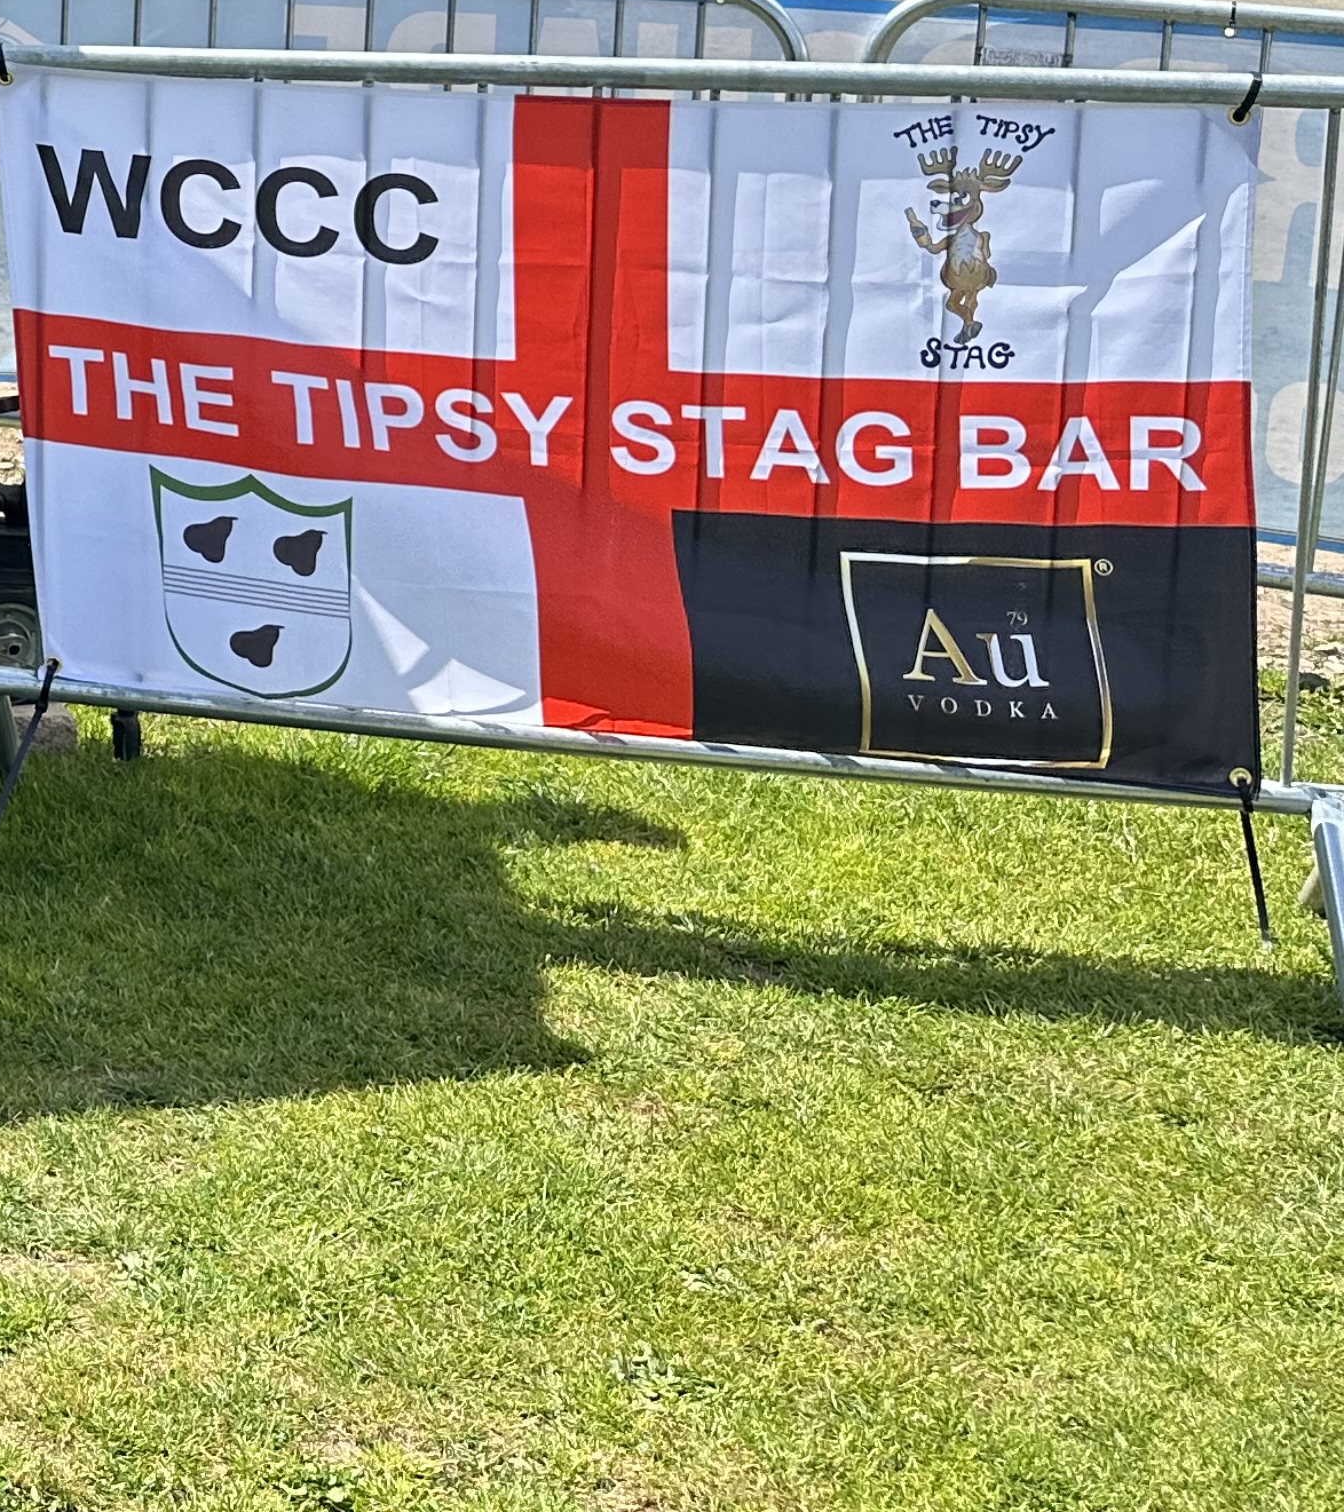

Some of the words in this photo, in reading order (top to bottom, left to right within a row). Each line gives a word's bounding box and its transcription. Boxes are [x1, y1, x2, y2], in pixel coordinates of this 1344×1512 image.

[893, 115, 954, 149] THE
[976, 114, 1056, 152] TIPSY
[36, 143, 440, 265] WCCC
[920, 337, 1015, 370] STAG
[48, 345, 240, 438] THE
[271, 369, 573, 467] TIPSY
[610, 400, 914, 488] STAG
[958, 415, 1207, 493] BAR
[1006, 611, 1029, 626] 79
[902, 608, 1050, 688] Au
[908, 694, 1059, 720] VODKA
